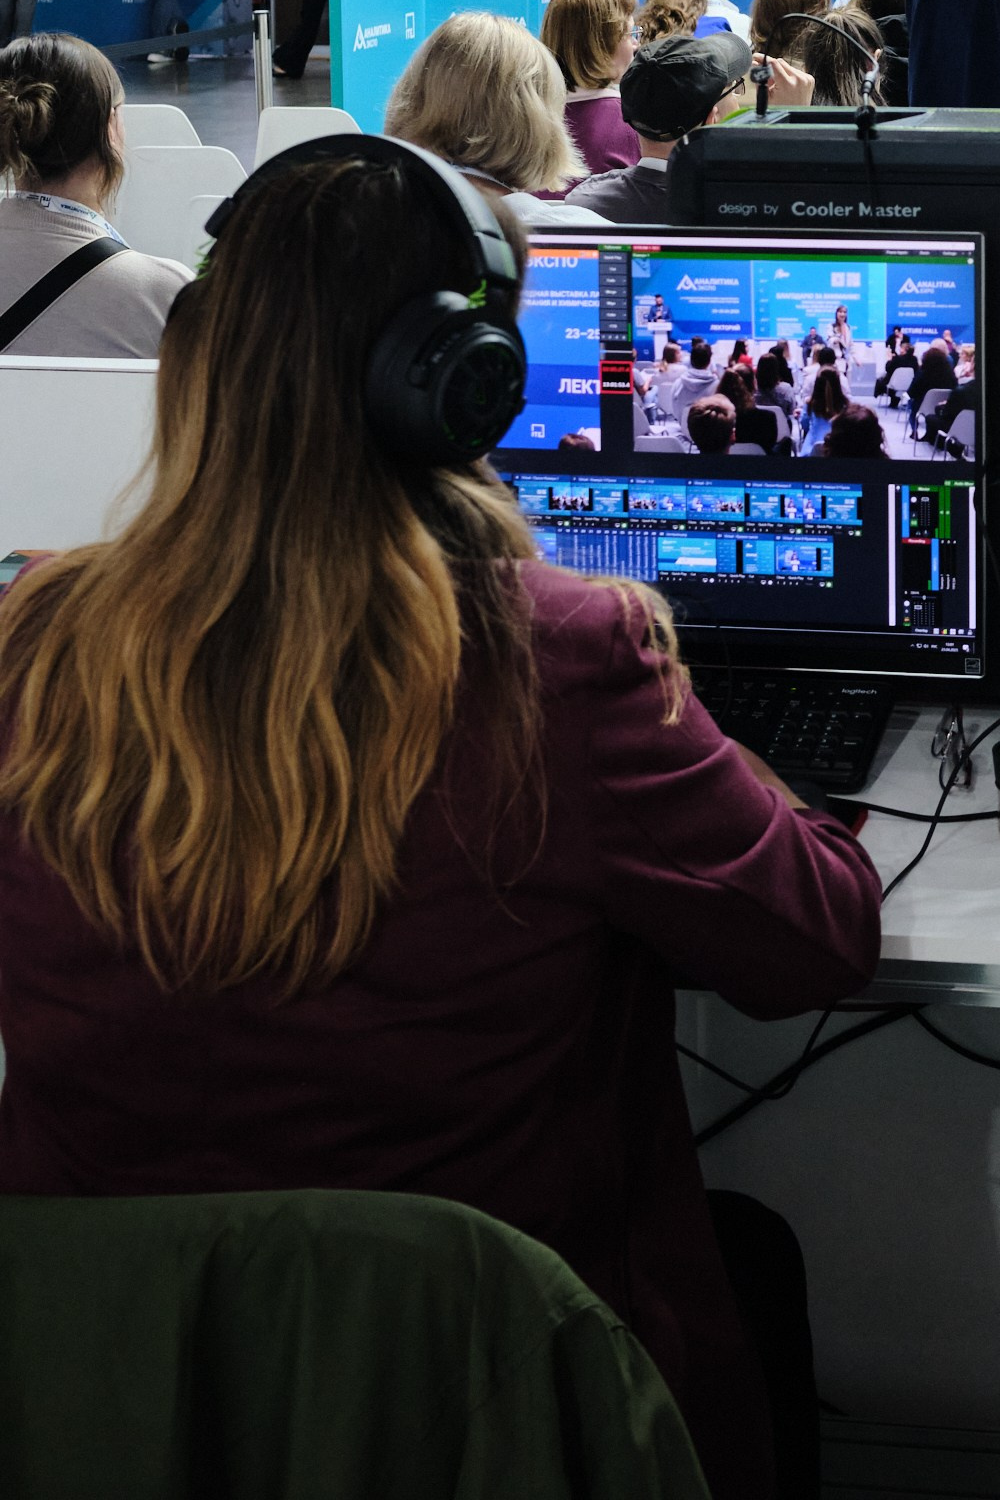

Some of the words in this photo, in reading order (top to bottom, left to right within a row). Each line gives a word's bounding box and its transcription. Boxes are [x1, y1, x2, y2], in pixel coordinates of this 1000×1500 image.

[718, 202, 757, 216] design
[763, 203, 779, 216] by
[791, 201, 853, 217] Cooler
[858, 202, 922, 217] Master
